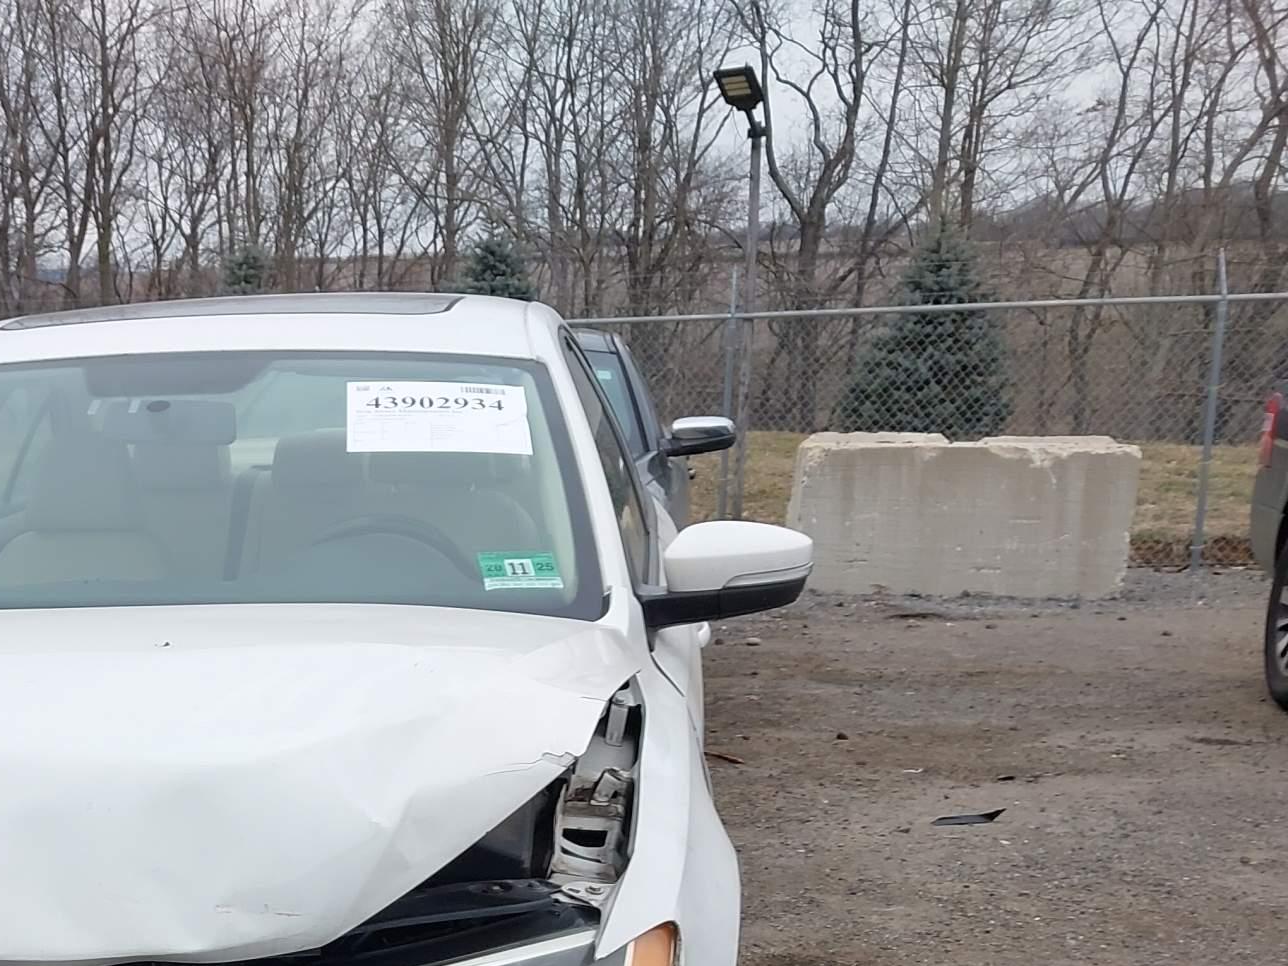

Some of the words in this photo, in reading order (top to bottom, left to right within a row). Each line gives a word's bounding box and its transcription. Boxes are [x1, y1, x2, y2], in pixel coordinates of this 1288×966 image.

[366, 396, 504, 410] 43902934
[508, 562, 530, 576] 11
[535, 562, 554, 571] 25
